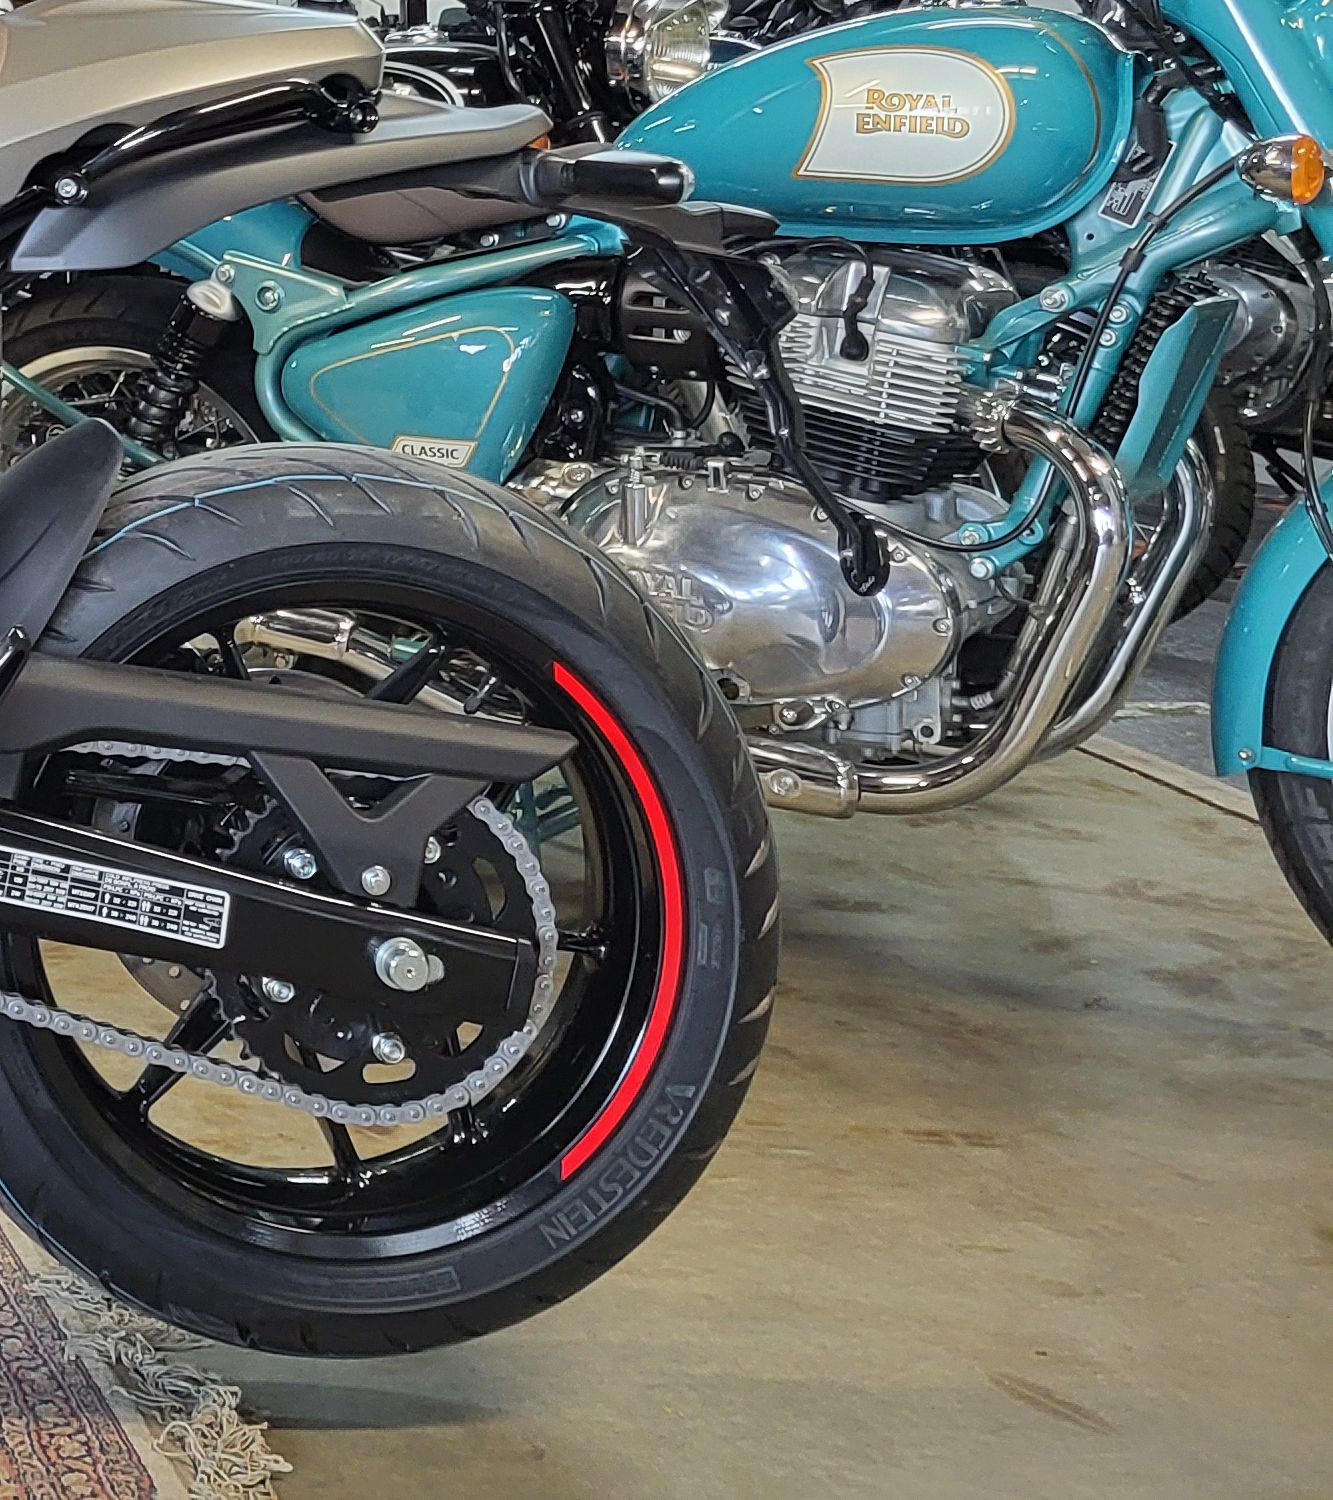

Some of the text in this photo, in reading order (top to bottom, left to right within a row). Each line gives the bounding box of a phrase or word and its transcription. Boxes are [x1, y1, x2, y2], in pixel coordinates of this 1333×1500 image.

[865, 87, 954, 115] ROYAL
[856, 112, 971, 141] ENFIELD
[401, 444, 460, 460] CLASSIC
[540, 1083, 697, 1250] VREDESTEIN
